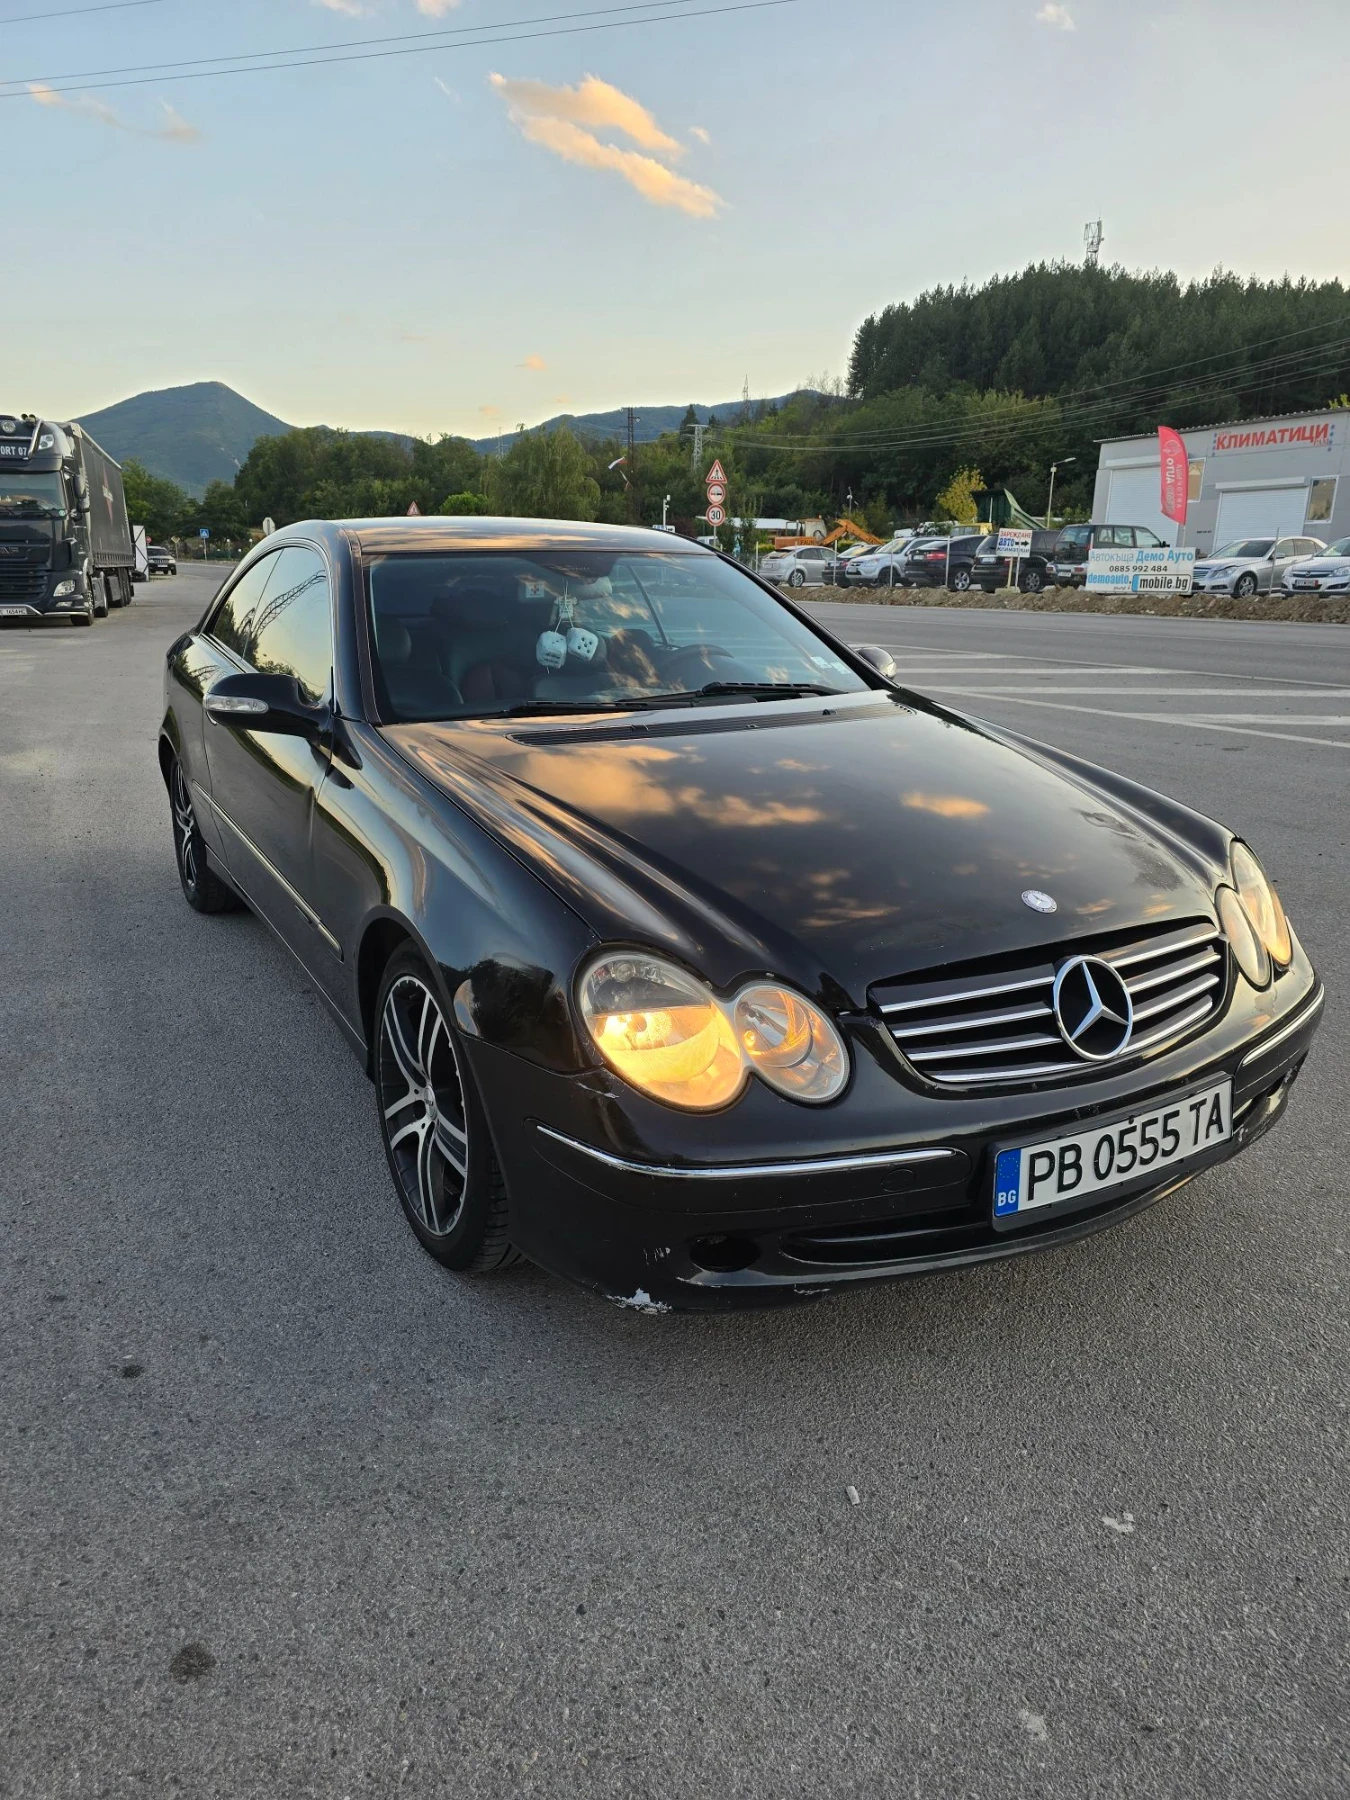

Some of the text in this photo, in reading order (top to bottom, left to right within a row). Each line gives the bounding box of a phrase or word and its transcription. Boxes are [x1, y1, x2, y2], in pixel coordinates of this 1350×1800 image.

[1215, 423, 1329, 450] КЛИМАТИЦИ
[18, 447, 27, 456] 07
[711, 510, 721, 520] 30
[1090, 550, 1194, 563] Автокъща Демо Ауто
[1140, 576, 1188, 590] mobile.bg
[1027, 1092, 1224, 1201] PB 0555 TA
[997, 1189, 1017, 1207] BG
